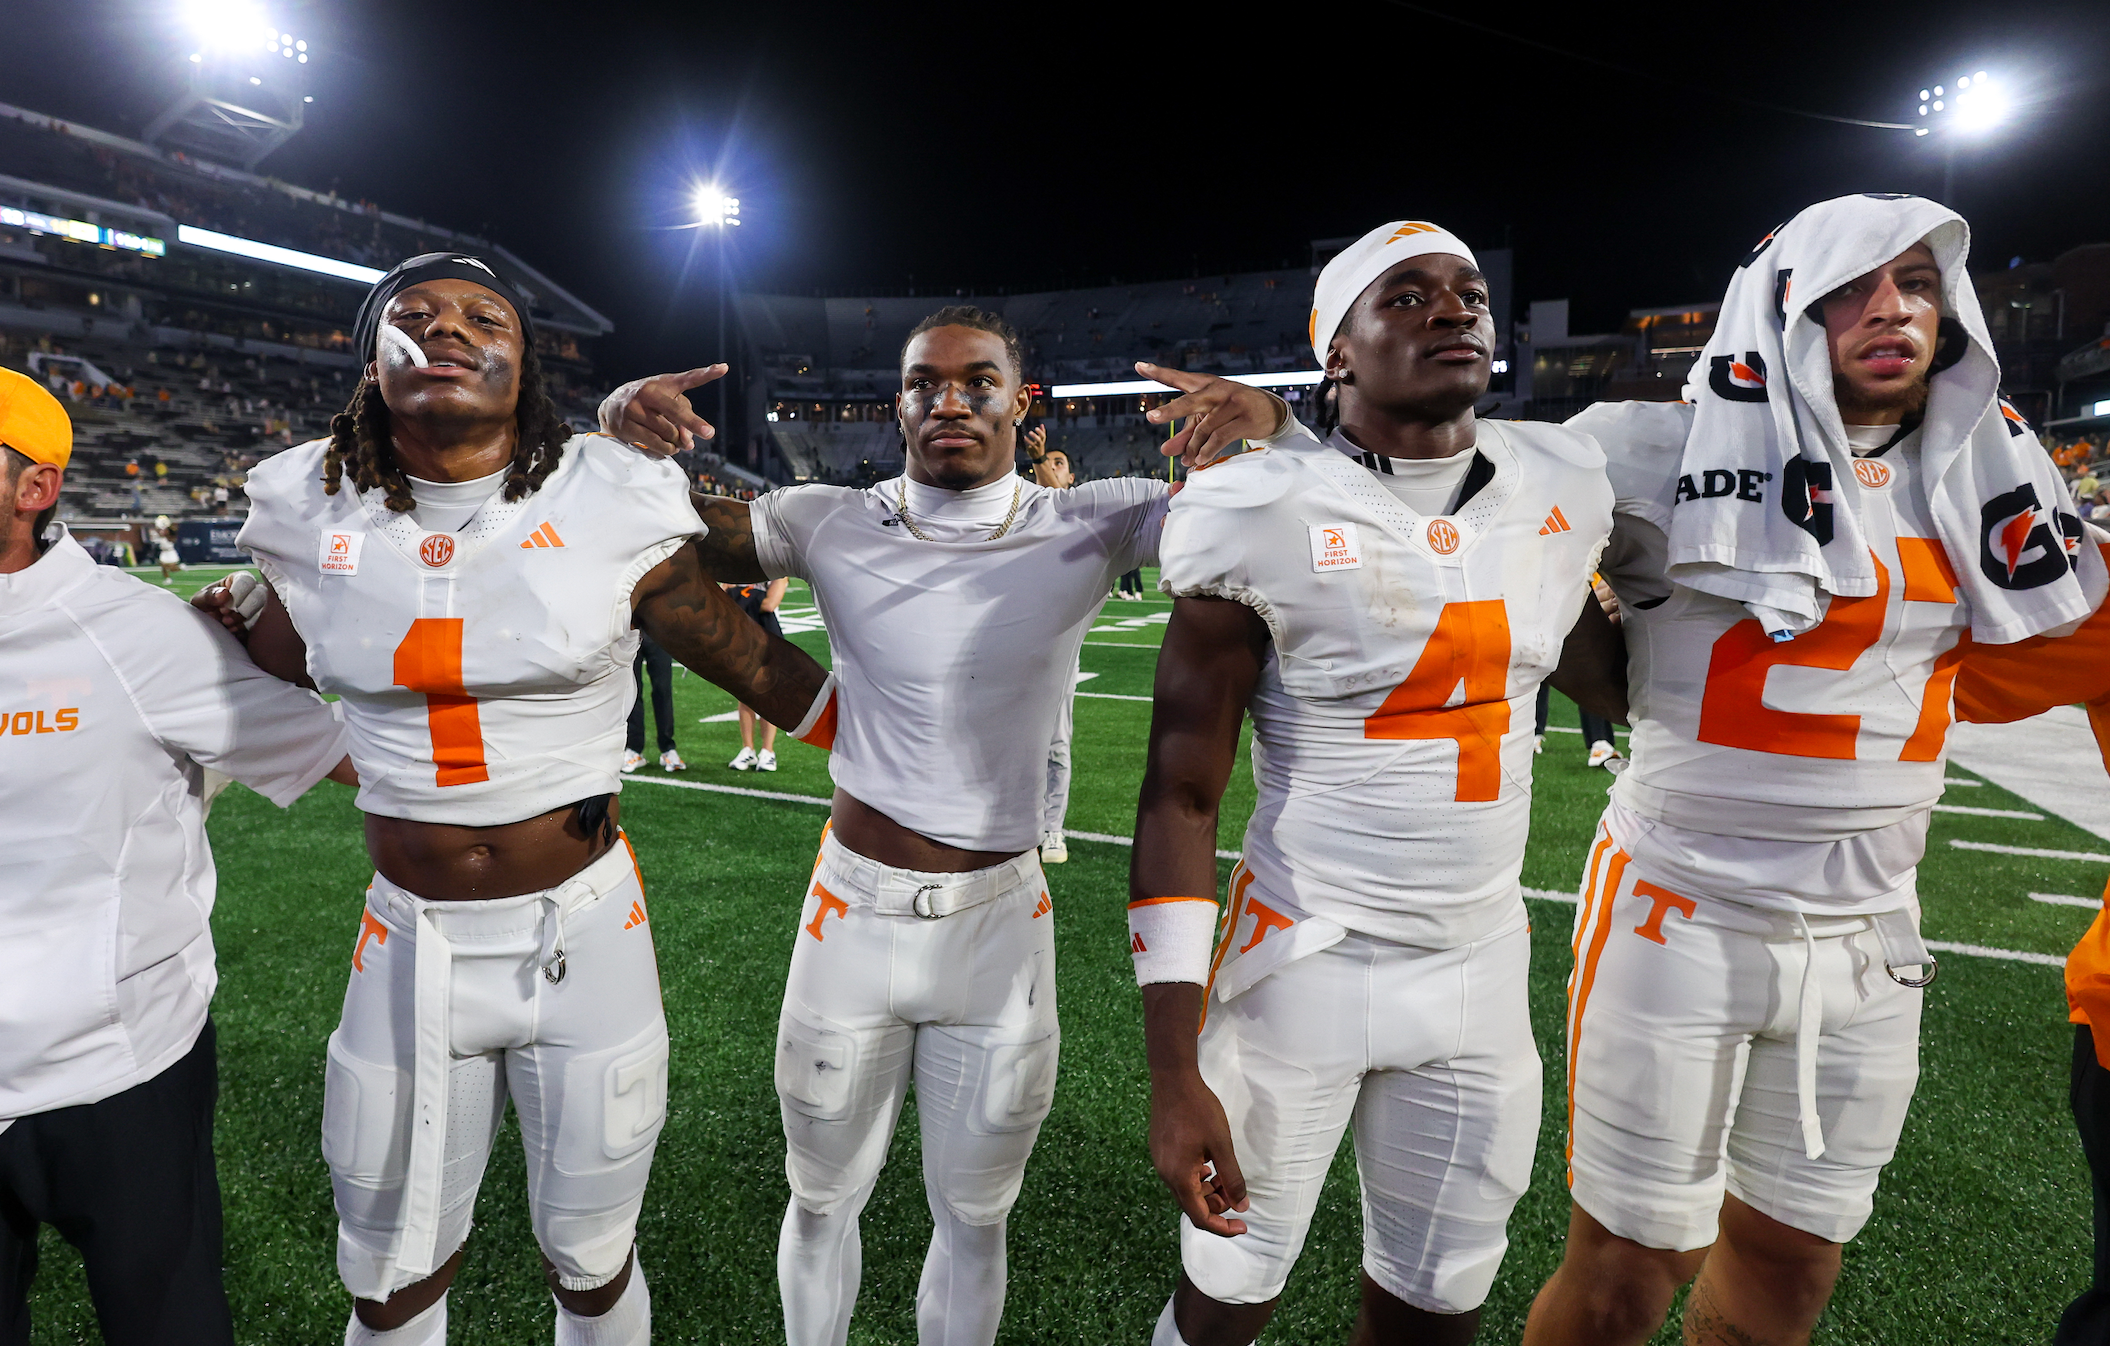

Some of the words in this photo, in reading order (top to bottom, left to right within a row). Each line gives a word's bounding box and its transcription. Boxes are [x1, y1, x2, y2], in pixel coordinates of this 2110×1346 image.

[1857, 461, 1889, 485] SEC
[423, 536, 452, 563] SEC
[1430, 523, 1458, 551] SEC
[1980, 482, 2069, 591] G
[321, 563, 354, 571] HORIZON
[327, 555, 348, 563] FIRST
[1318, 557, 1358, 567] HORIZON
[1324, 550, 1348, 558] FIRST
[393, 617, 489, 787] 1
[1364, 599, 1512, 802] 4
[805, 881, 850, 942] T
[1632, 879, 1697, 946] T
